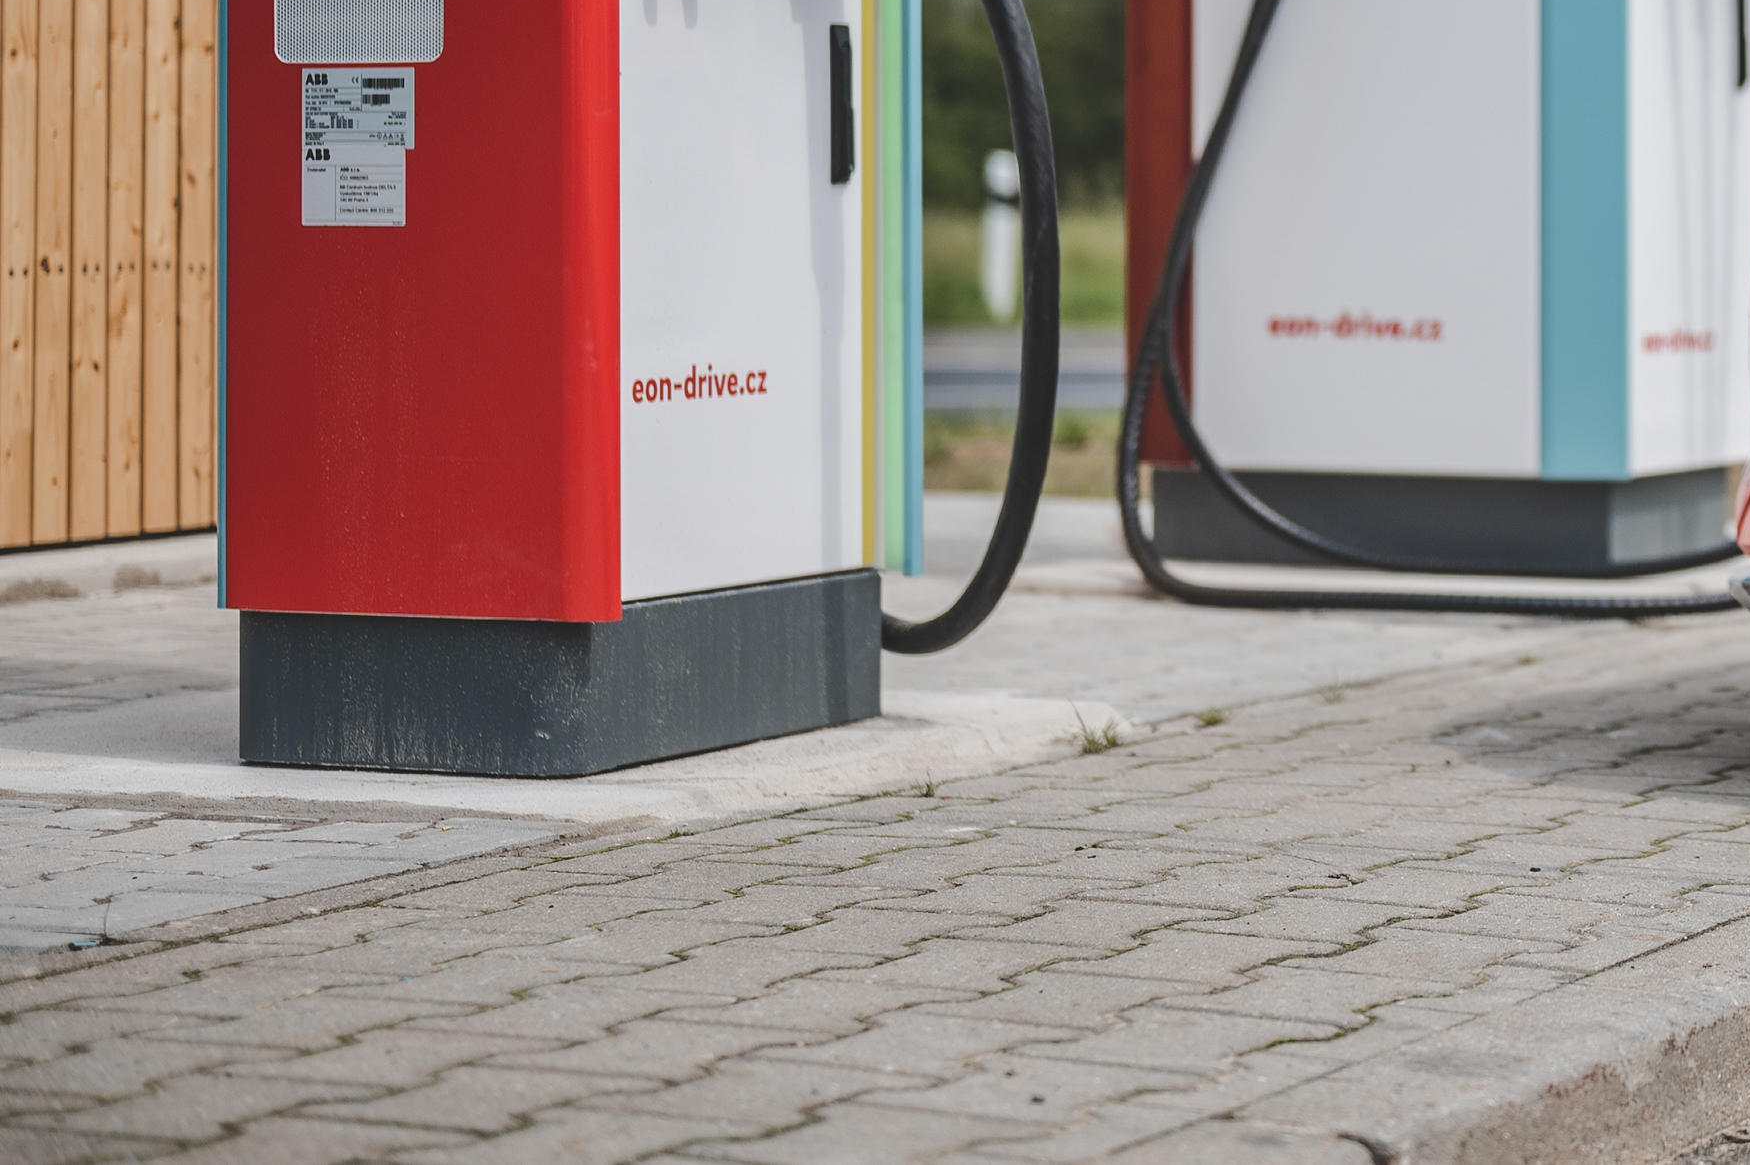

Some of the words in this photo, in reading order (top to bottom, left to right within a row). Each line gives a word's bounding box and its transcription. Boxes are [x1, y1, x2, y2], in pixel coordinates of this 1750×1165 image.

[305, 73, 328, 86] ABB
[305, 148, 331, 161] ABB
[632, 363, 768, 403] eon-drive.cz
